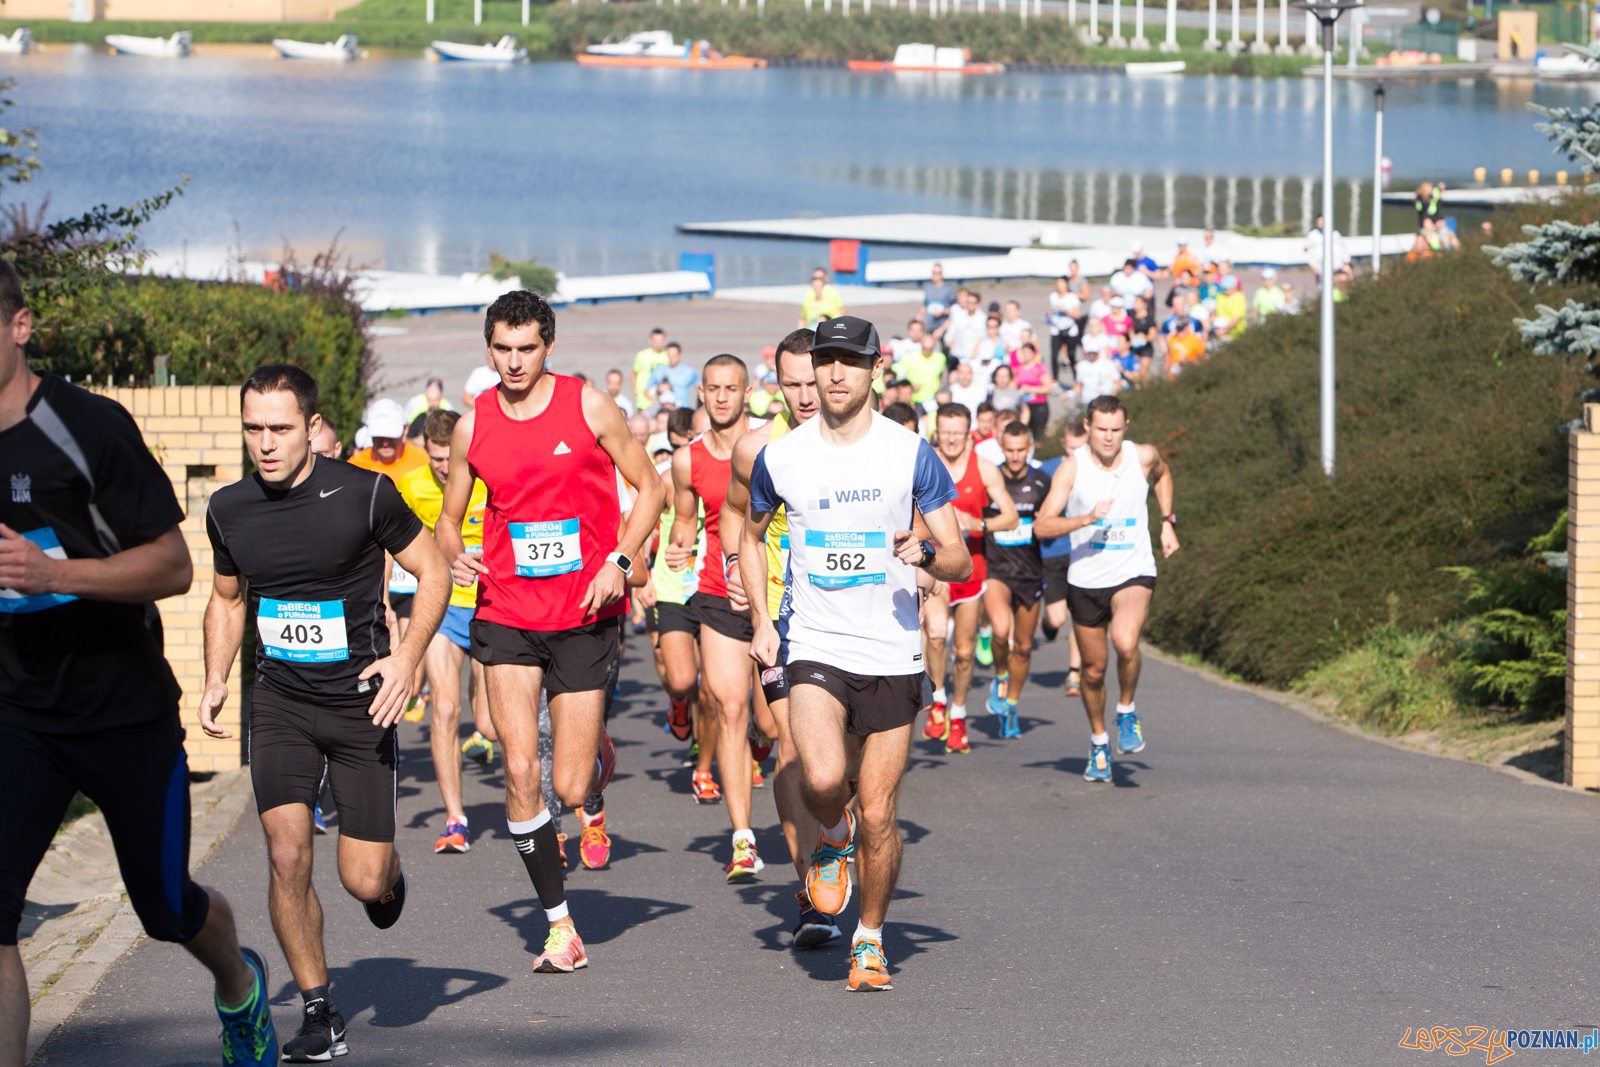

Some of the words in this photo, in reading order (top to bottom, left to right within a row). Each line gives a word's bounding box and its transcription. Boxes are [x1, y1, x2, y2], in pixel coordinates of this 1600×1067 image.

[525, 523, 562, 532] zaBIEGaj
[825, 533, 865, 542] zaBIEGaj
[1103, 529, 1126, 542] 585
[527, 541, 565, 560] 373
[826, 553, 866, 571] 562
[277, 603, 321, 614] zaBIEGaj
[280, 624, 324, 644] 403
